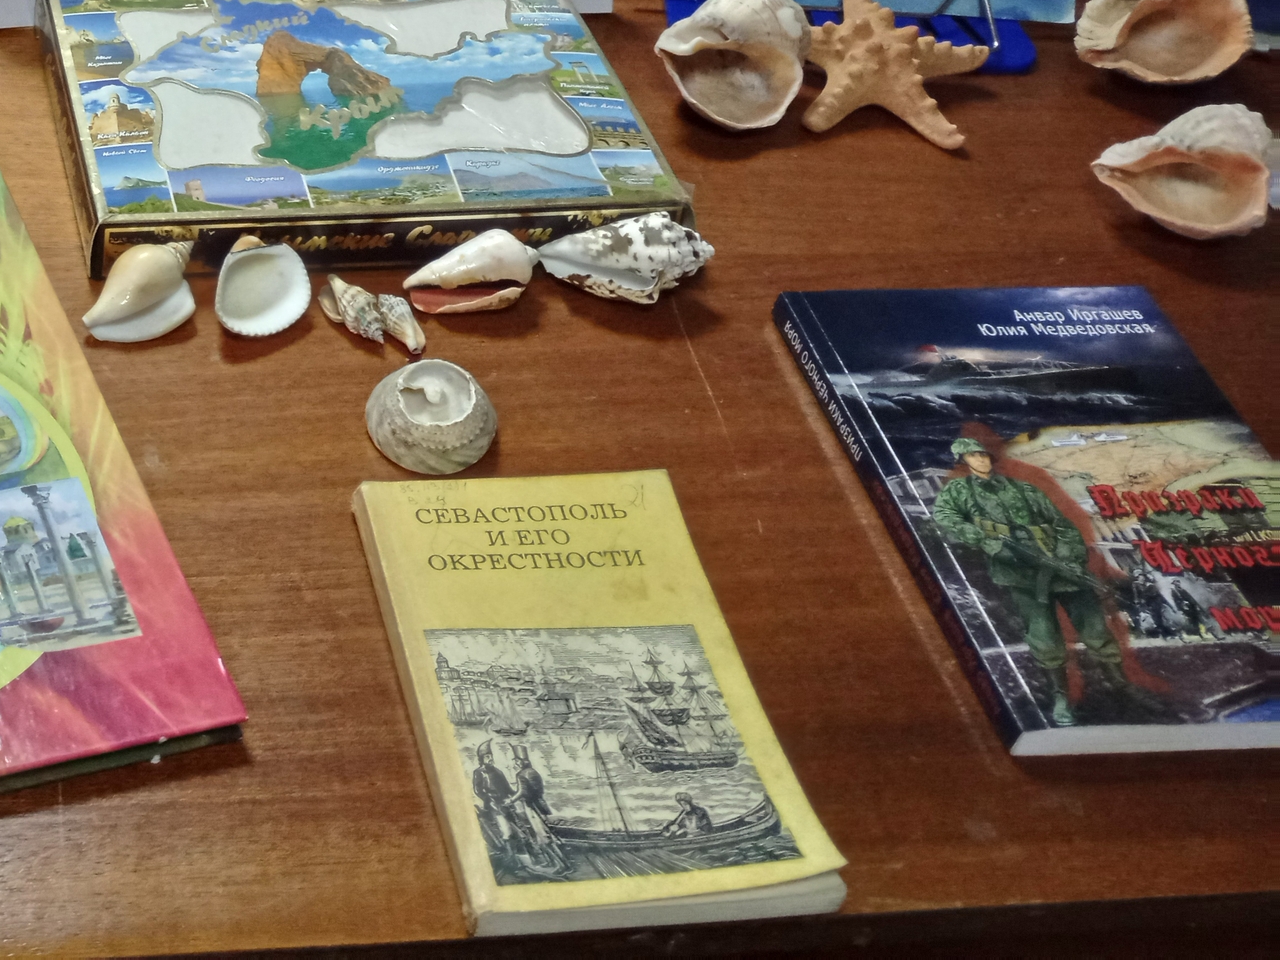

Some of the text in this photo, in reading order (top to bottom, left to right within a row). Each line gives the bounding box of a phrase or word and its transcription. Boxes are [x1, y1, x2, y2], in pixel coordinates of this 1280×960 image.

[200, 10, 311, 54] Сладкий
[298, 86, 405, 140] Крым
[1013, 307, 1144, 324] Анвар Иргашев
[783, 320, 803, 354] МОРЯ
[977, 322, 1156, 338] Юлия Медведовская
[827, 399, 863, 462] ПРИЗРАКИ
[415, 502, 628, 525] СЕВАСТОПОЛЬ
[1085, 483, 1266, 518] Призраки
[485, 528, 571, 547] И ЕГО
[427, 549, 646, 571] ОКРЕСТНОСТИ
